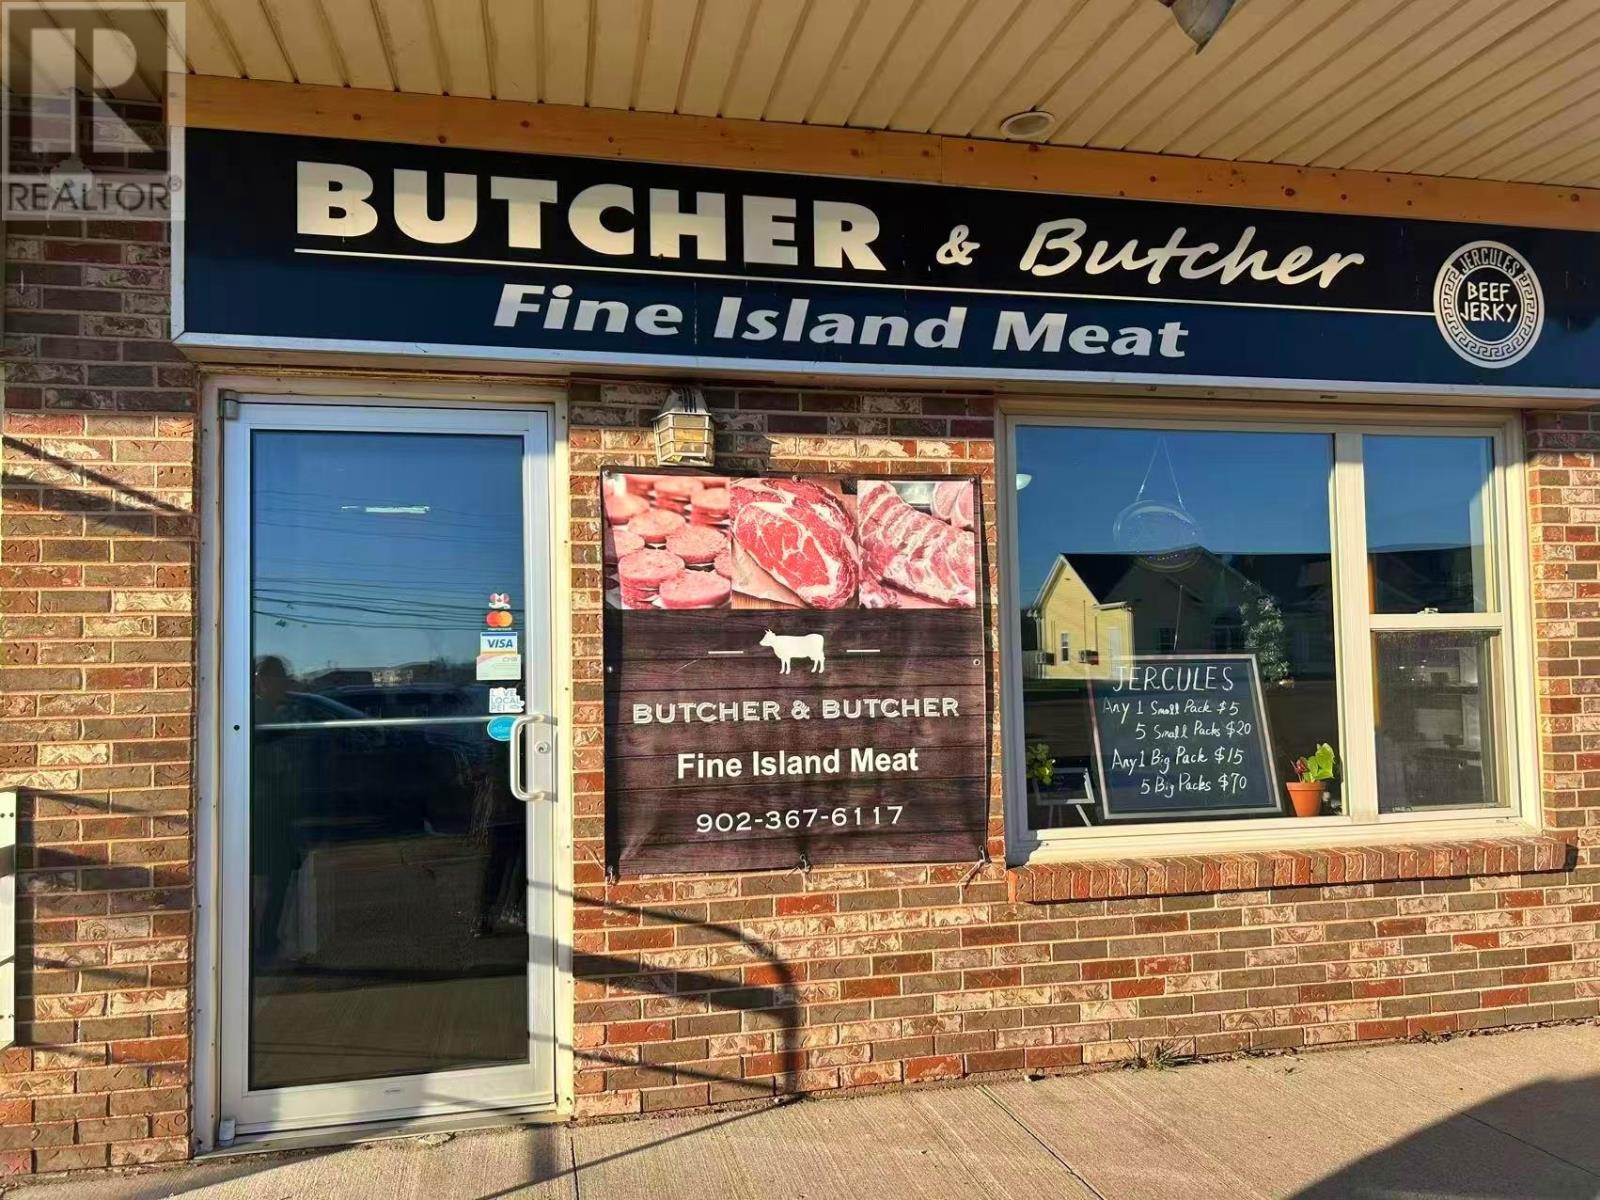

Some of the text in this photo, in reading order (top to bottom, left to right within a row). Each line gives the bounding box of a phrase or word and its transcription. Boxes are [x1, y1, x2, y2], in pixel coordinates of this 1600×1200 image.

[296, 160, 1365, 289] BUTCHER & Butcher
[1459, 247, 1521, 277] JERCULES
[1467, 281, 1511, 302] BEEF
[493, 283, 1190, 358] Fine Island Meat
[1459, 301, 1518, 323] JERKY
[487, 638, 513, 649] VISA
[1112, 665, 1234, 692] JERCULES
[491, 696, 521, 705] LOCAL
[632, 697, 960, 724] BUTCHER & BUTCHER
[1102, 698, 1240, 724] Any 1 Small Pack $5
[1135, 719, 1252, 740] 5 Small Packs $20
[677, 747, 919, 779] Fine Island Meat
[1111, 749, 1137, 776] Any
[1151, 748, 1170, 774] Big
[1175, 746, 1208, 765] Pack
[1214, 746, 1244, 765] $15
[1140, 773, 1248, 798] 5 Big Packs $70
[696, 805, 904, 833] 902-367-6117
